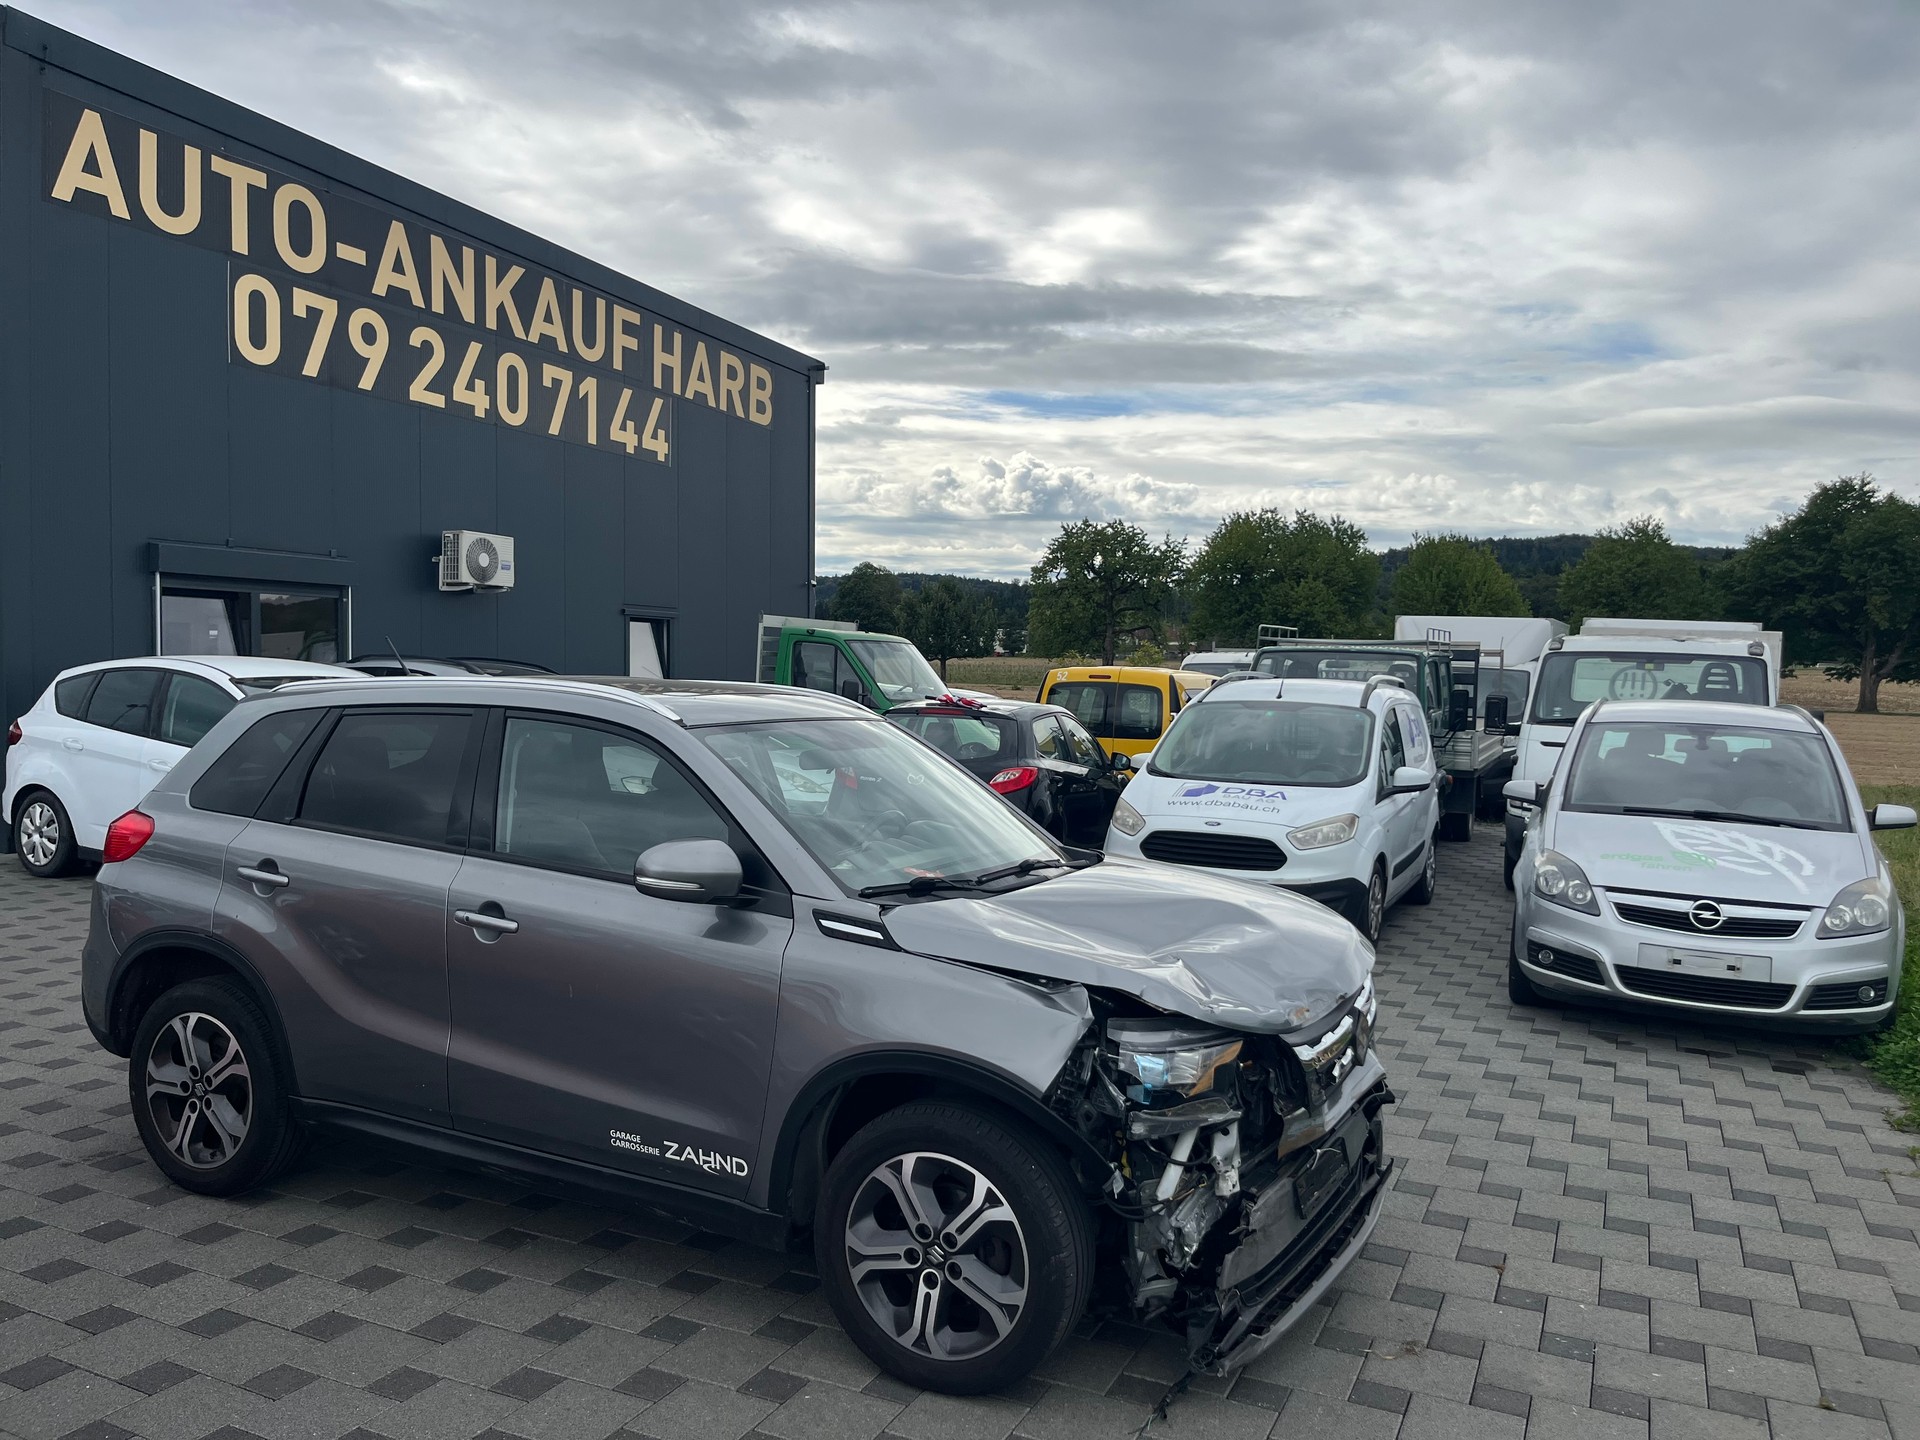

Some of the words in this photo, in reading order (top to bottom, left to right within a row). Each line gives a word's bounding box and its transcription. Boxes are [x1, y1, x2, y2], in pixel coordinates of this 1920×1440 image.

[51, 108, 641, 370] AUTO-ANKAUF
[653, 324, 773, 426] HARB
[233, 273, 390, 391] 079
[409, 326, 529, 427] 240
[542, 363, 597, 445] 71
[609, 388, 669, 462] 44
[1056, 671, 1069, 681] 52
[1221, 786, 1287, 801] DBA
[1167, 799, 1281, 814] www.dbabau.ch
[609, 1129, 642, 1144] GARAGE
[610, 1138, 661, 1156] CARROSSERIE
[663, 1140, 749, 1177] ZAHND
